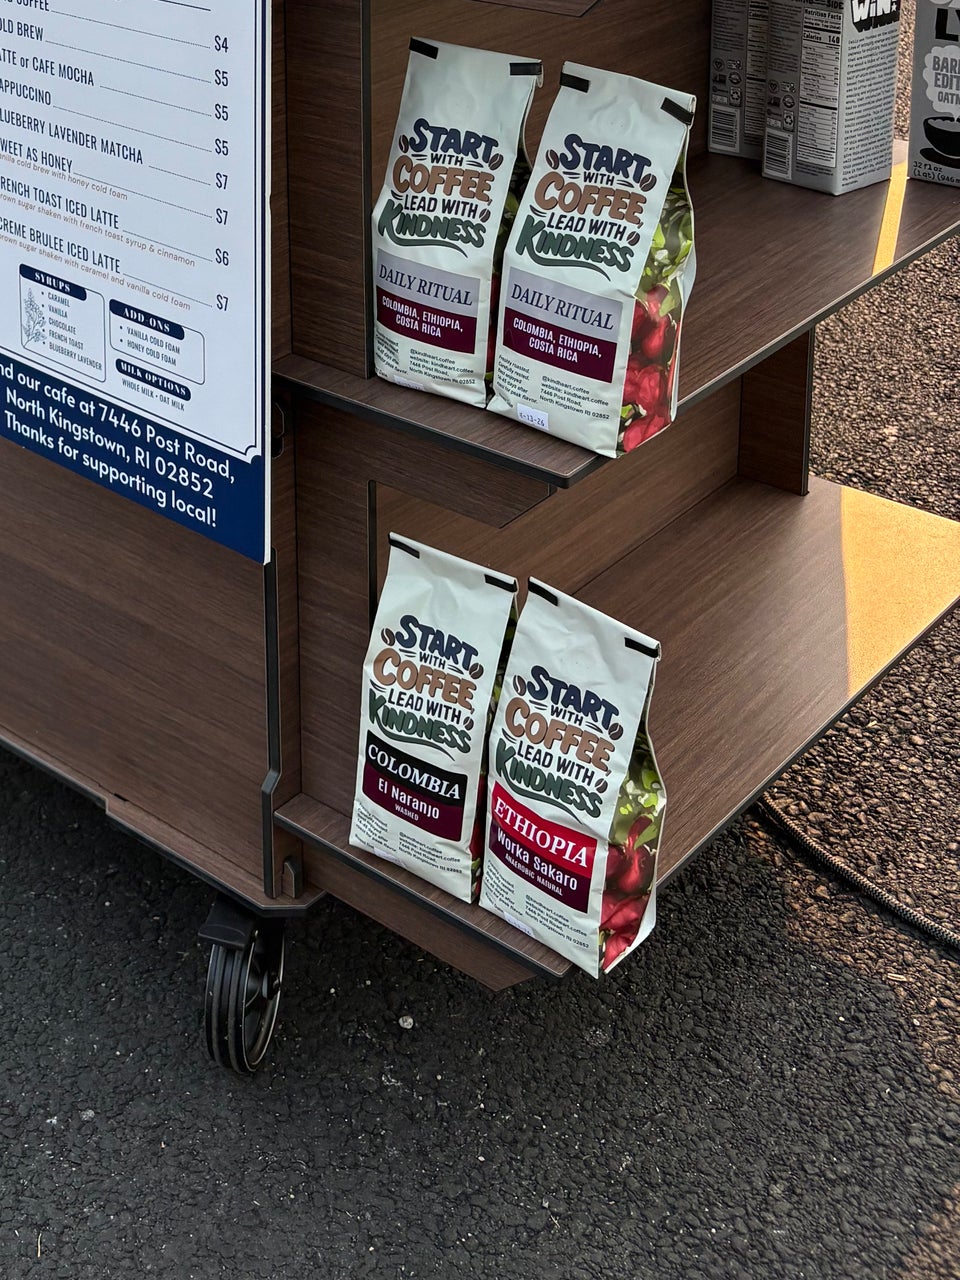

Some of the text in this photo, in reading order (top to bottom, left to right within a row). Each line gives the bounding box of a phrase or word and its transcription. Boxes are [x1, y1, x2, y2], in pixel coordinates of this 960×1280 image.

[17, 21, 44, 42] BREW
[214, 35, 229, 53] $4
[20, 57, 29, 69] or
[32, 56, 55, 76] CAFE
[59, 63, 94, 87] MOCHA
[214, 68, 229, 87] $5
[214, 103, 229, 121] $5
[49, 122, 97, 150] LAVENDER
[100, 138, 143, 165] MATCHA
[215, 138, 229, 156] $5
[408, 118, 499, 163] START
[430, 153, 464, 166] WITH
[559, 133, 652, 184] START
[16, 157, 31, 169] cold
[32, 163, 50, 175] brew
[51, 169, 67, 181] with
[68, 173, 90, 189] honey
[91, 182, 107, 194] cold
[109, 187, 128, 201] foam
[26, 146, 38, 163] AS
[41, 150, 73, 174] HONEY
[583, 171, 615, 186] WITH
[215, 173, 228, 190] $7
[33, 186, 62, 210] TOAST
[65, 198, 87, 218] ICED
[90, 206, 119, 230] LATTE
[215, 208, 228, 226] $7
[377, 198, 487, 250] KINDNESS
[403, 194, 479, 219] LEAD WITH
[18, 198, 36, 210] sugar
[38, 206, 62, 220] shaken
[63, 214, 78, 226] with
[79, 219, 103, 235] french
[104, 229, 124, 242] toast
[125, 236, 147, 251] syrup
[148, 244, 155, 253] &
[157, 248, 196, 267] cinnamon
[515, 214, 634, 273] KINDNESS
[546, 211, 627, 241] LEAD WITH
[29, 227, 64, 253] BRULEE
[67, 241, 89, 262] ICED
[92, 250, 121, 274] LATTE
[215, 248, 229, 266] $6
[19, 240, 37, 253] sugar
[39, 248, 63, 263] shaken
[64, 257, 79, 269] with
[81, 264, 109, 280] caramel
[110, 274, 125, 286] and
[126, 280, 150, 296] vanilla
[152, 290, 169, 303] cold
[171, 295, 191, 311] foam
[34, 271, 71, 293] SYRUPS
[379, 264, 473, 306] DAILY RITUAL
[216, 294, 229, 312] $7
[382, 295, 464, 333] COLOMBIA, ETHIOPIA,
[510, 283, 614, 330] DAILY RITUAL
[126, 326, 148, 342] VANILLA
[395, 315, 442, 338] COSTA RICA
[513, 317, 602, 358] COLOMBIA, ETHIOPIA,
[49, 342, 77, 359] BLUEBERRY
[127, 339, 145, 353] HONEY
[528, 336, 578, 363] COSTA RICA
[120, 361, 186, 396] MILK OPTIONS
[6, 386, 214, 499] North Kingstown, RI 02852
[17, 372, 41, 392] our
[43, 384, 76, 408] cafe
[79, 400, 96, 417] at
[98, 403, 142, 438] 7446
[146, 424, 181, 456] Post
[184, 441, 235, 485] Road,
[4, 409, 217, 528] Thanks for supporting local!
[395, 614, 479, 671] START
[419, 652, 446, 669] WITH
[388, 688, 462, 725] LEAD WITH
[526, 665, 620, 731] START
[550, 704, 584, 726] WITH
[369, 688, 472, 754] KINDNESS
[368, 744, 460, 800] COLOMBIA
[495, 737, 603, 819] KINDNESS
[517, 740, 596, 787] LEAD WITH
[378, 777, 440, 820] El Naranjo
[395, 803, 419, 821] WASHED
[494, 796, 588, 868] ETHIOPIA
[497, 827, 529, 864] Worka
[533, 856, 578, 891] Sakaro
[504, 853, 535, 879] ANAEROBIC
[536, 874, 563, 896] NATURAL
